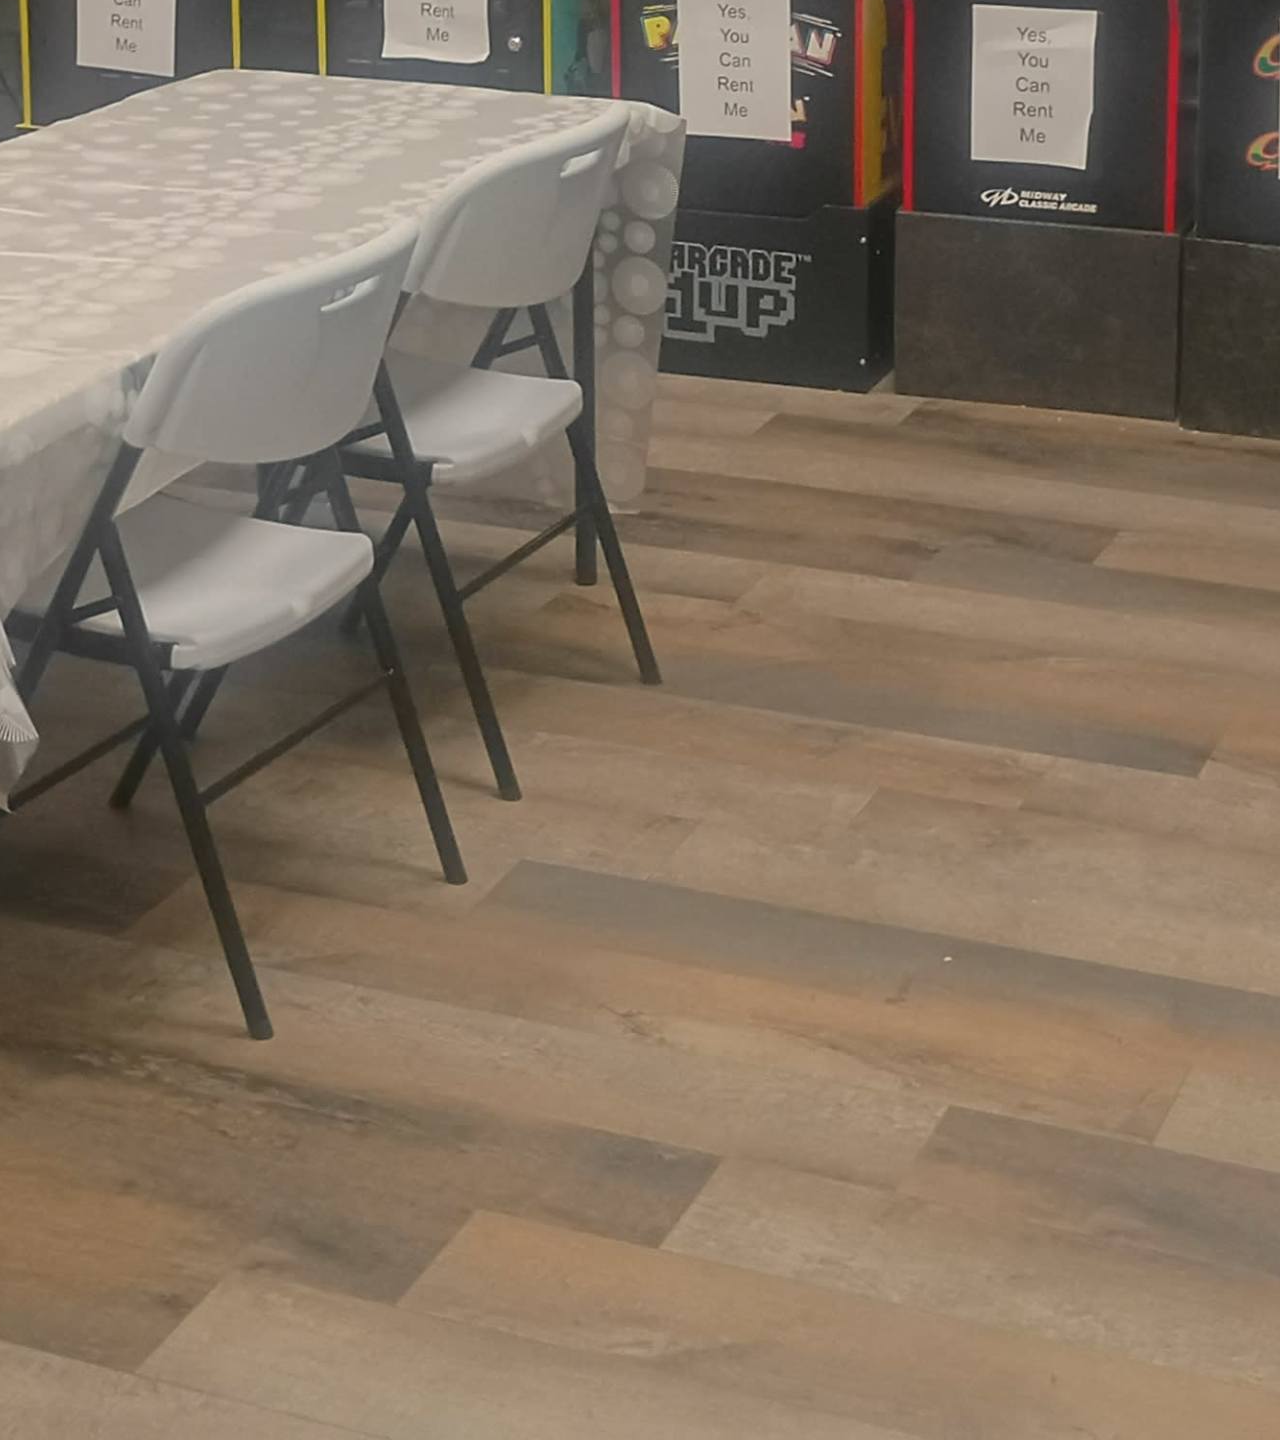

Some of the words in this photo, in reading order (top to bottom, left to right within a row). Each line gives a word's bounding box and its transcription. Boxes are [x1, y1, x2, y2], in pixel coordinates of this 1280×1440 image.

[420, 2, 455, 19] Rent
[110, 13, 143, 31] Rent
[425, 27, 450, 42] Me
[720, 28, 750, 44] You
[1016, 26, 1052, 46] Yes,
[115, 37, 138, 52] Me
[719, 52, 751, 68] Can
[1017, 51, 1050, 69] You
[717, 75, 754, 93] Rent
[1015, 76, 1051, 94] Can
[723, 101, 749, 118] Me
[1012, 101, 1054, 119] Rent
[1019, 128, 1047, 143] Me
[1018, 200, 1058, 210] CLASSIC
[1059, 202, 1099, 214] ARCADE
[670, 241, 797, 290] ARCADE
